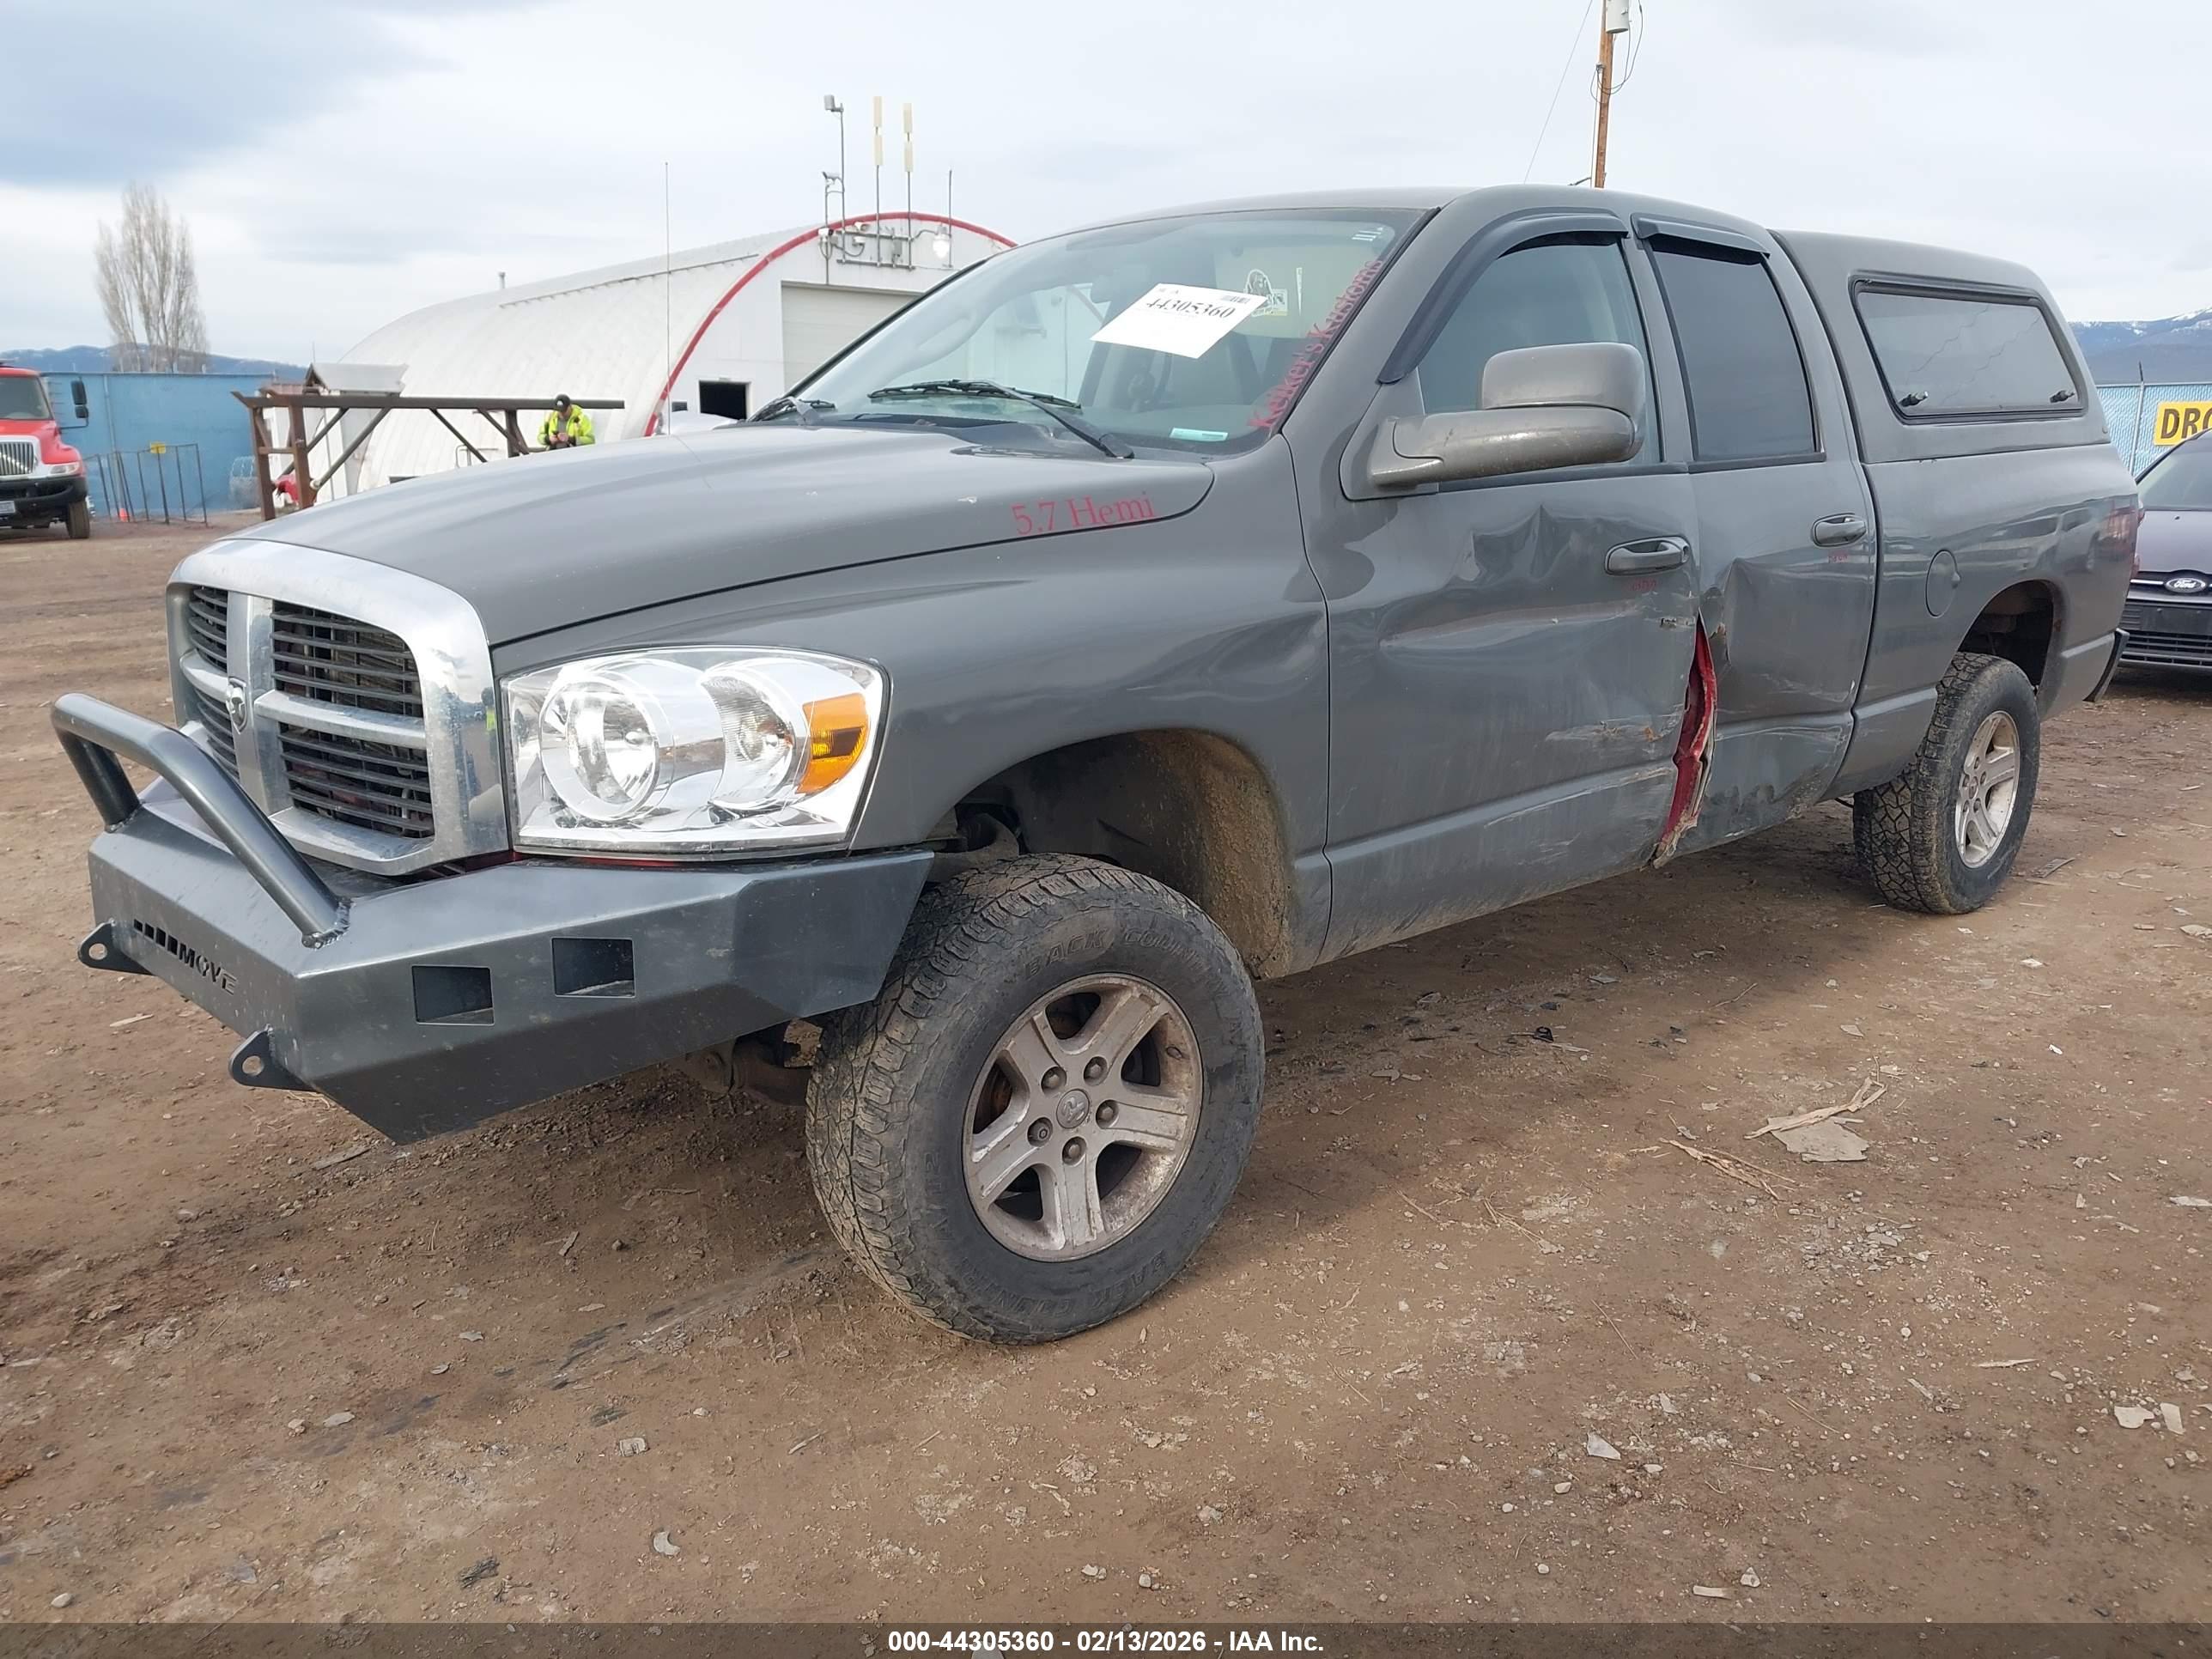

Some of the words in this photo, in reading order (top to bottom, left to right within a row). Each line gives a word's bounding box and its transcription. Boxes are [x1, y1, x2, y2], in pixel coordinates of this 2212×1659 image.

[1146, 297, 1236, 319] 44305360
[1305, 261, 1382, 339] Kustoms
[1011, 500, 1057, 537] 5.7
[1065, 494, 1156, 527] Hemi
[2173, 580, 2197, 589] Ford
[179, 942, 236, 996] MOVE
[1024, 927, 1108, 981] BACK
